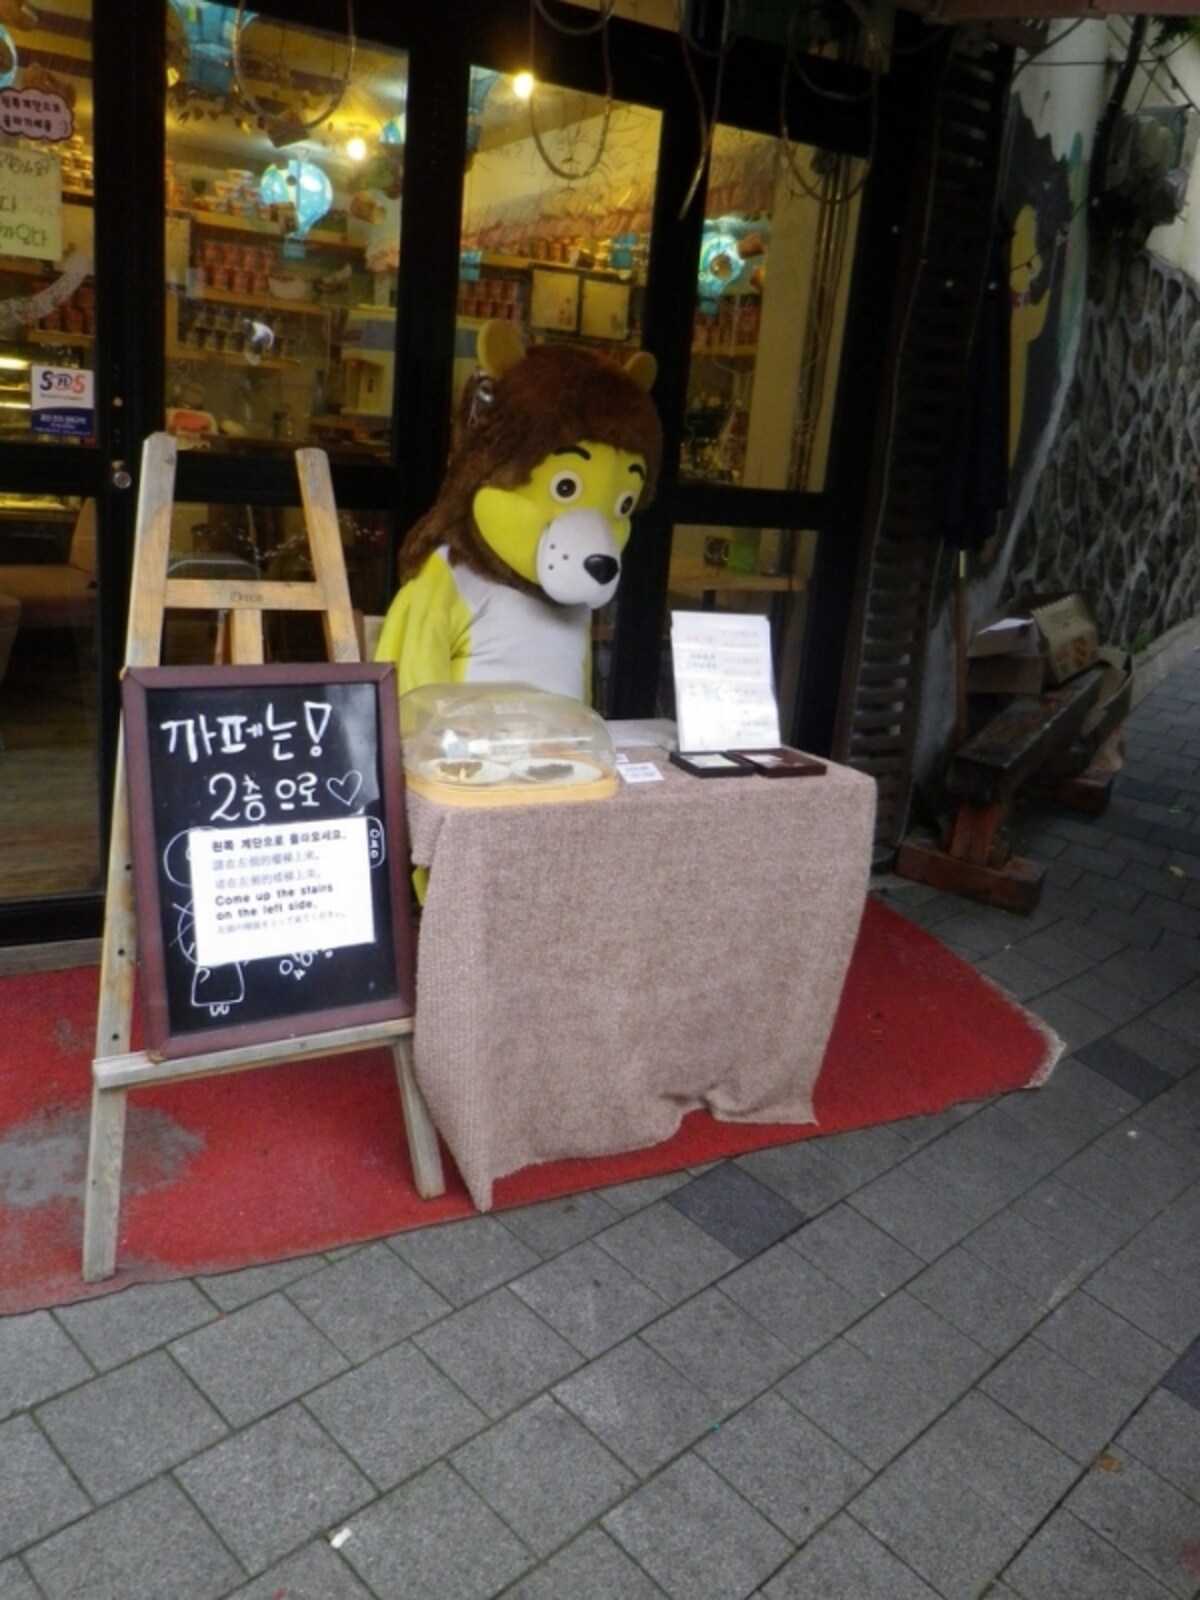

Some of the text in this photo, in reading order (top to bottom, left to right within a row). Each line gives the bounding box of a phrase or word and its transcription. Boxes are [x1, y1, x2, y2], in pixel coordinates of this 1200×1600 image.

[214, 884, 333, 907] Come up the stairs
[215, 911, 232, 921] on
[238, 908, 257, 918] the
[263, 903, 283, 915] left
